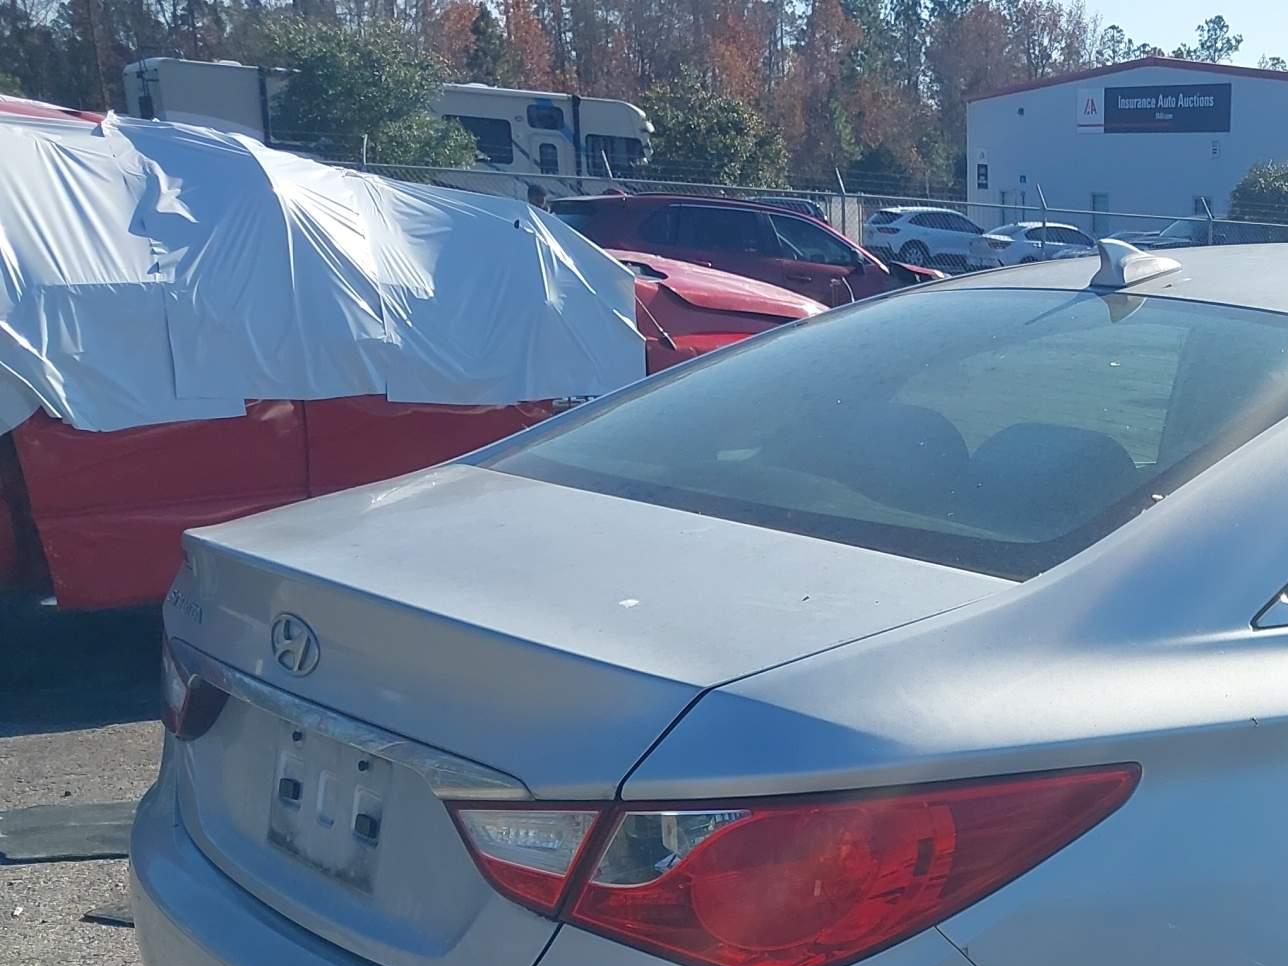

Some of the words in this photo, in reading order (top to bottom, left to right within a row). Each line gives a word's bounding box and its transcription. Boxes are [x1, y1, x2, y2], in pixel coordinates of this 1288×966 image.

[1118, 95, 1156, 109] Insurance
[1157, 93, 1176, 108] Auto
[1177, 92, 1215, 108] Auctions
